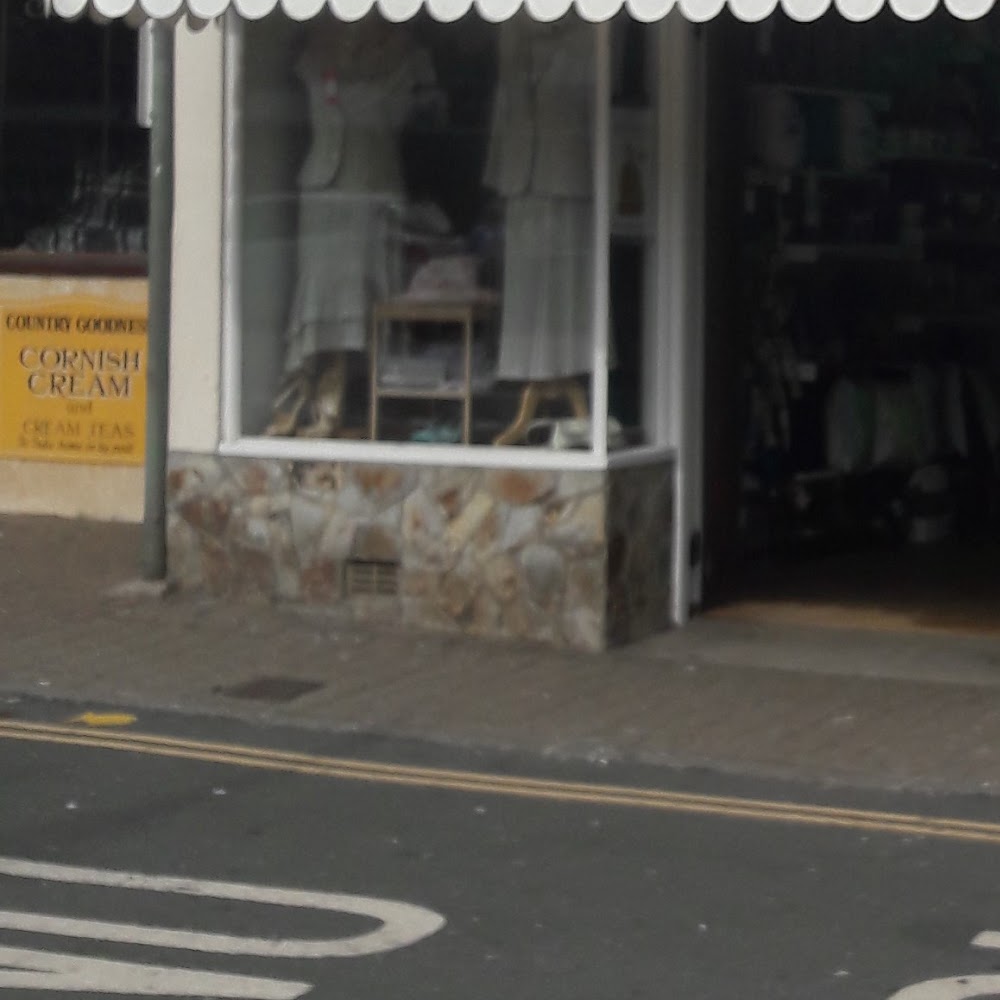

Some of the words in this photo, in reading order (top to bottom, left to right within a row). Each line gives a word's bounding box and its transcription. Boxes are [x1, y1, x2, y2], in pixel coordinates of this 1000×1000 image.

[6, 314, 71, 333] COUNTRY
[19, 346, 141, 373] CORNISH
[27, 372, 132, 398] CREAM
